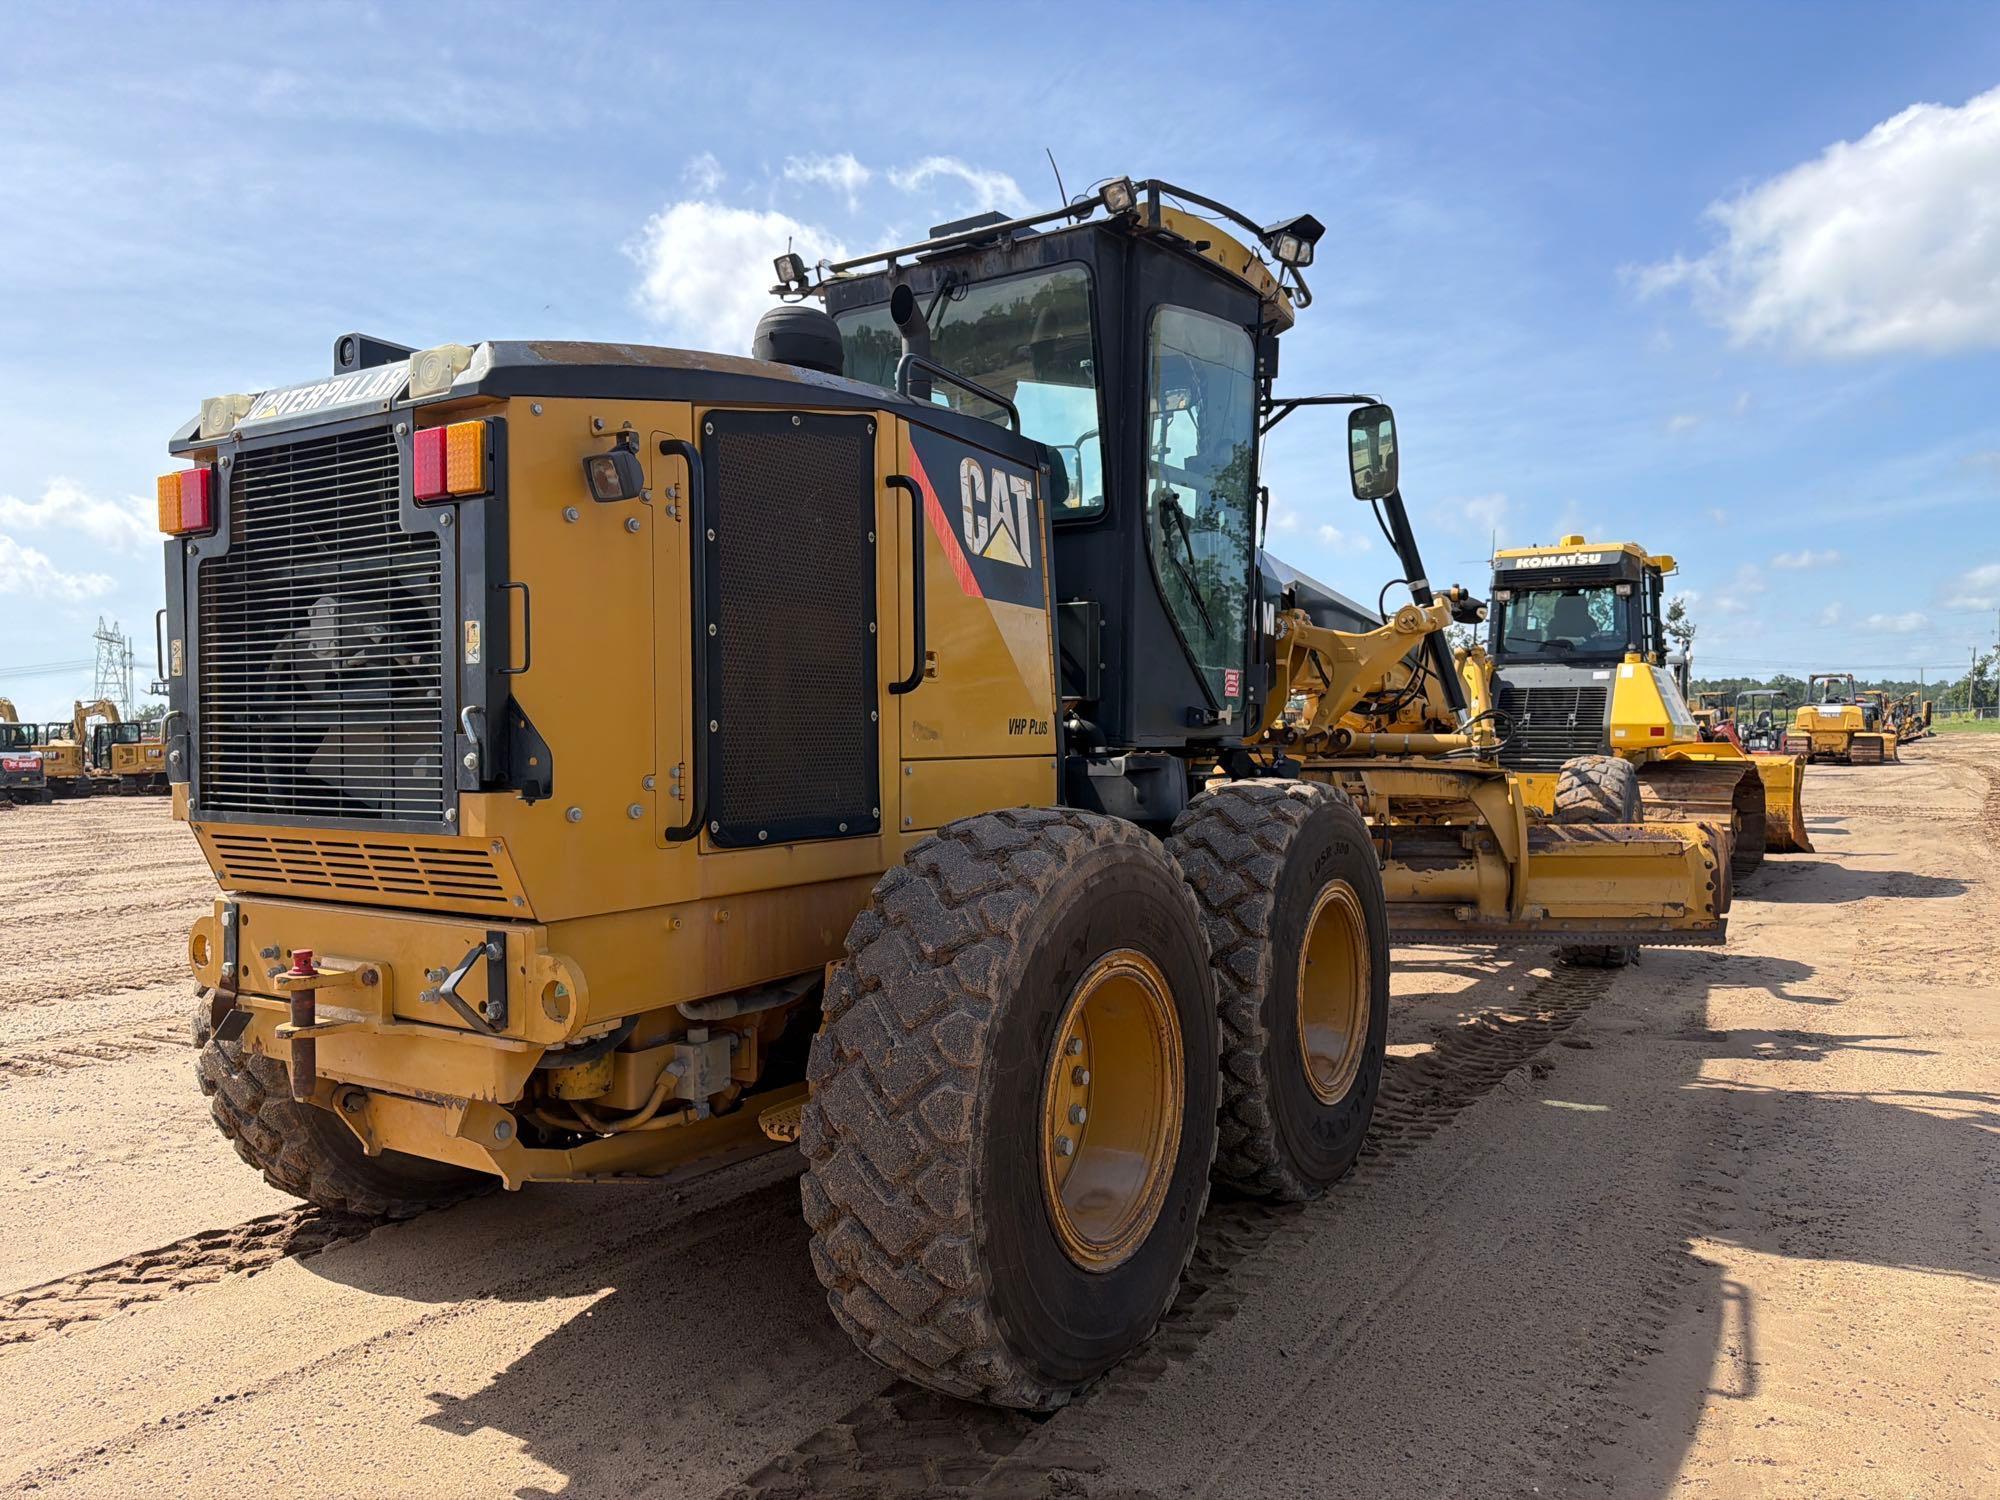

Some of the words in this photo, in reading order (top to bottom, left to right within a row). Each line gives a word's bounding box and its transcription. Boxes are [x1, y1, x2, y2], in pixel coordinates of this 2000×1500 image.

[250, 366, 408, 420] CATERPILLAR
[960, 457, 1033, 569] CAT
[1515, 553, 1602, 569] KOMATSU
[1008, 717, 1027, 736] VHP
